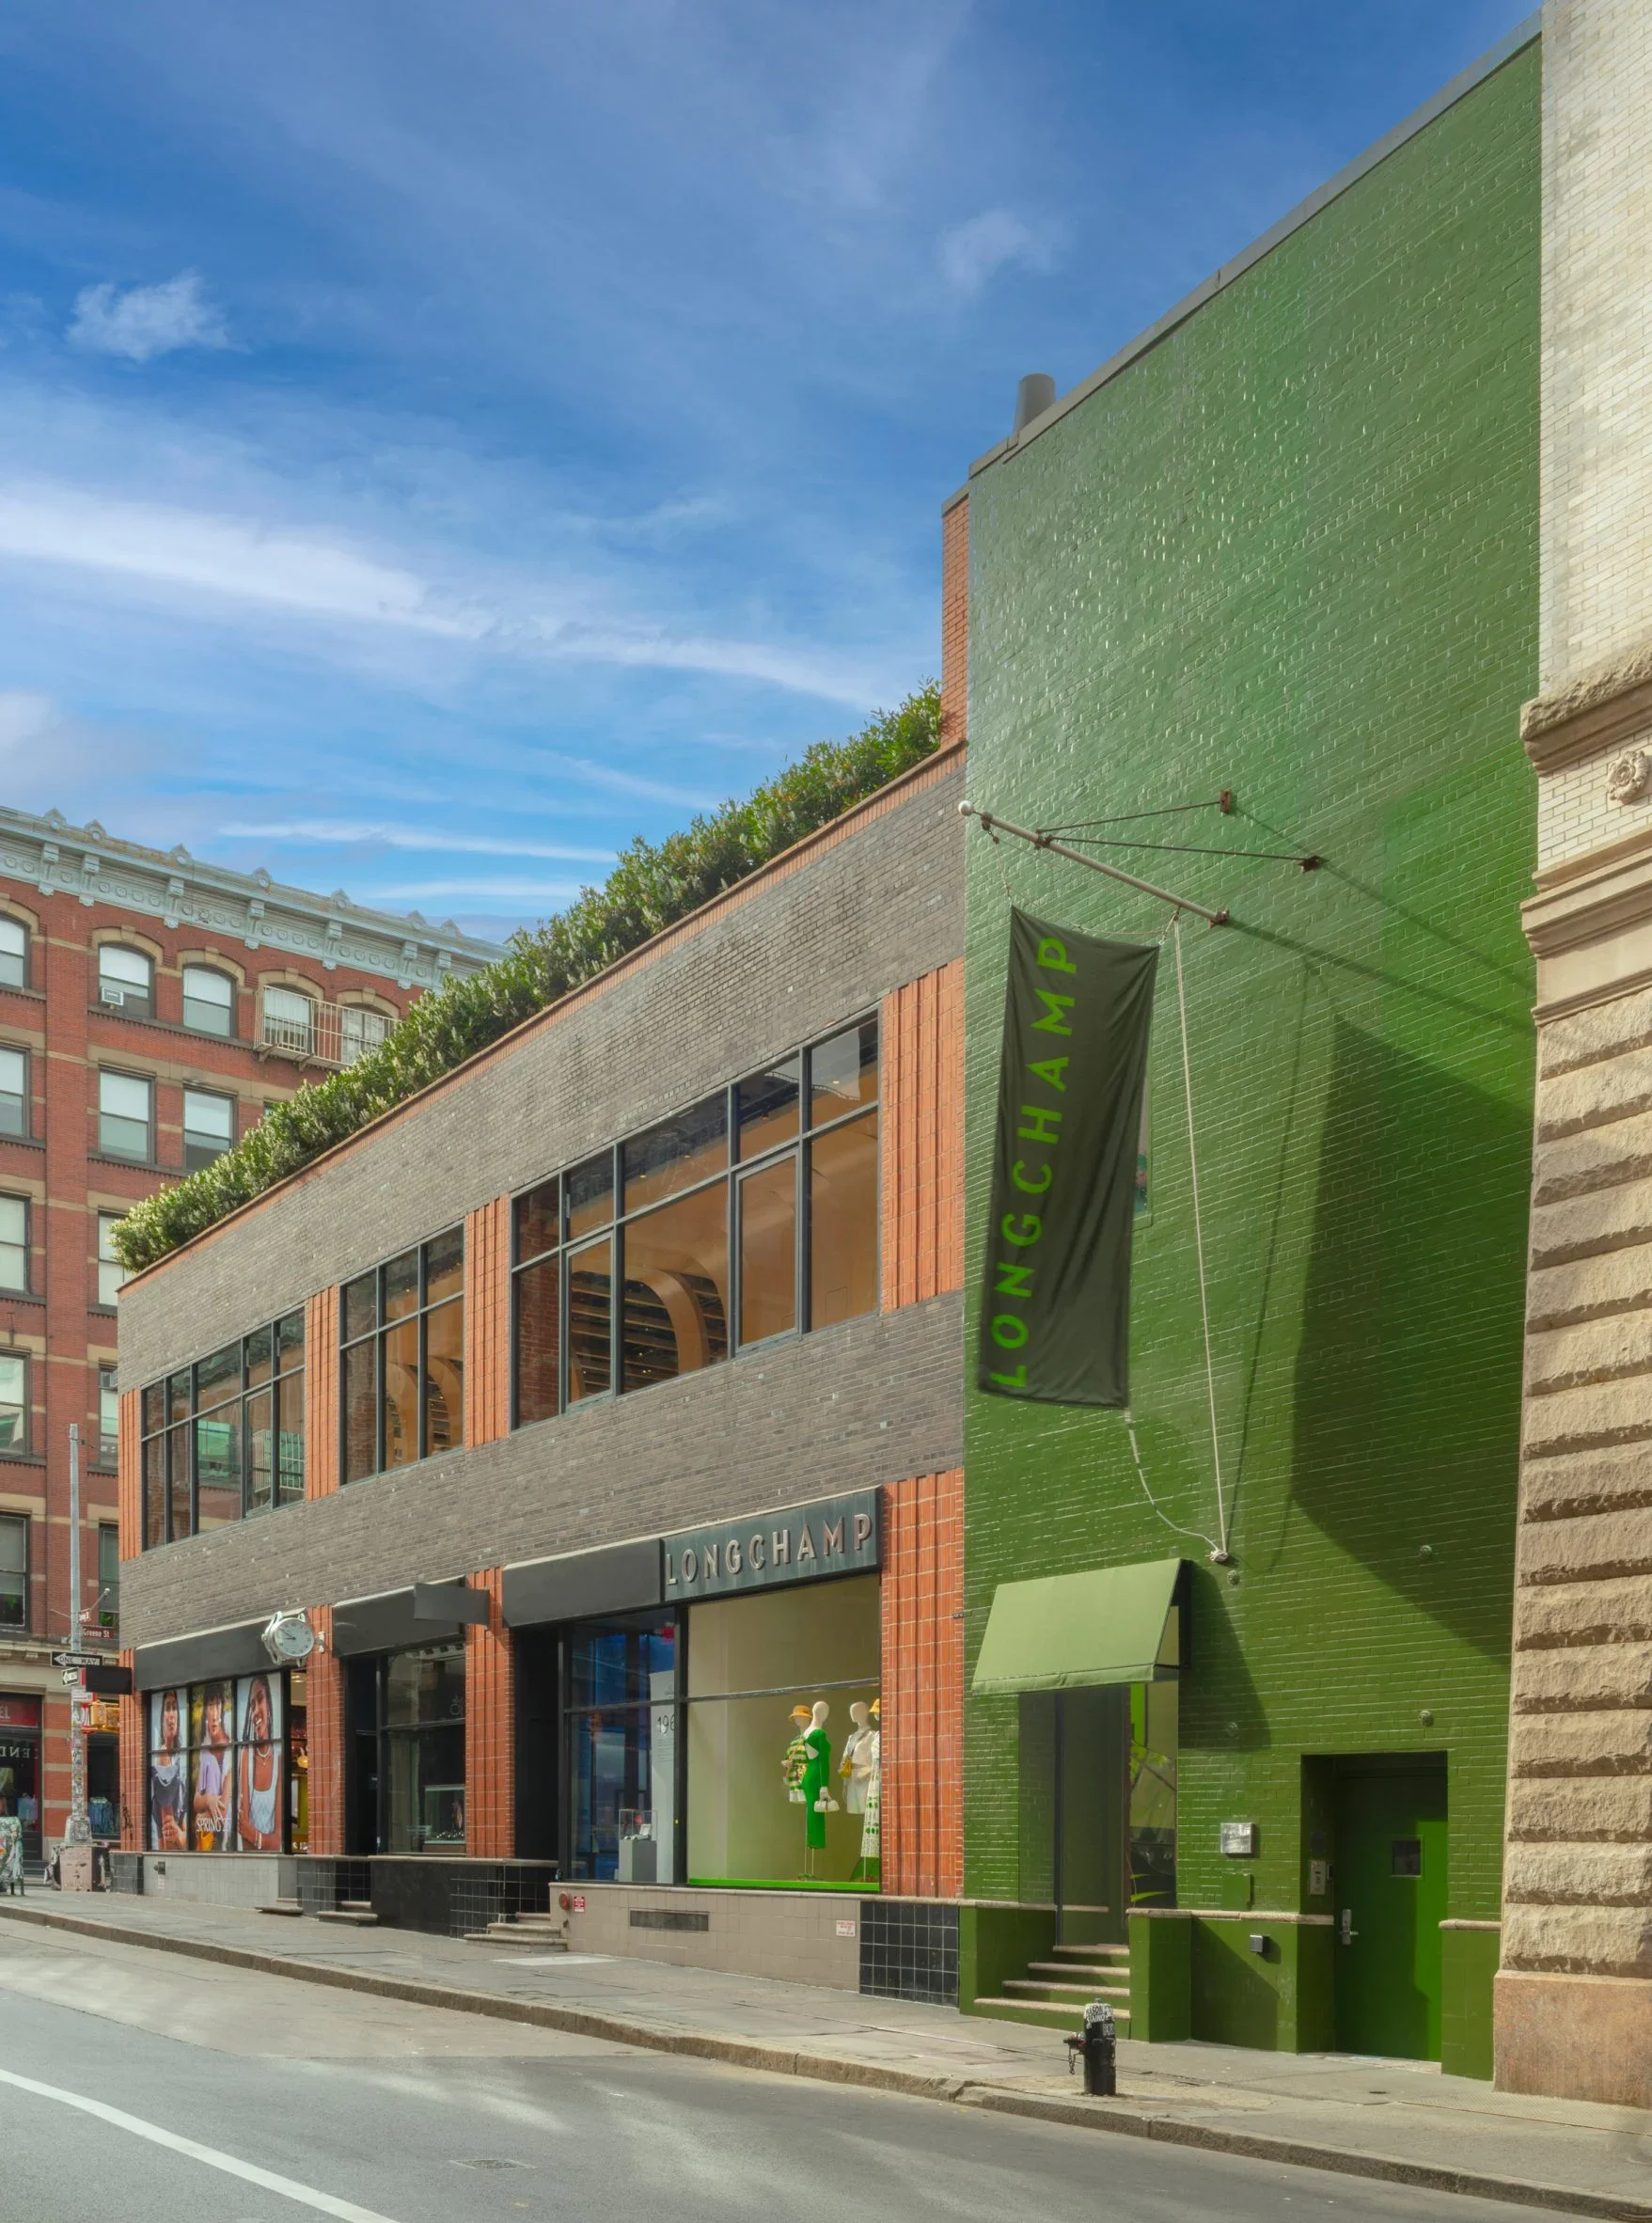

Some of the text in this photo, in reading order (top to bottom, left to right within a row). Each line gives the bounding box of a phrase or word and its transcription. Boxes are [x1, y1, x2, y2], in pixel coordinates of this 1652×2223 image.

[990, 936, 1077, 1389] LONGCHAMP
[665, 1513, 872, 1586] LONGCHAMP
[83, 1628, 110, 1638] Greene St
